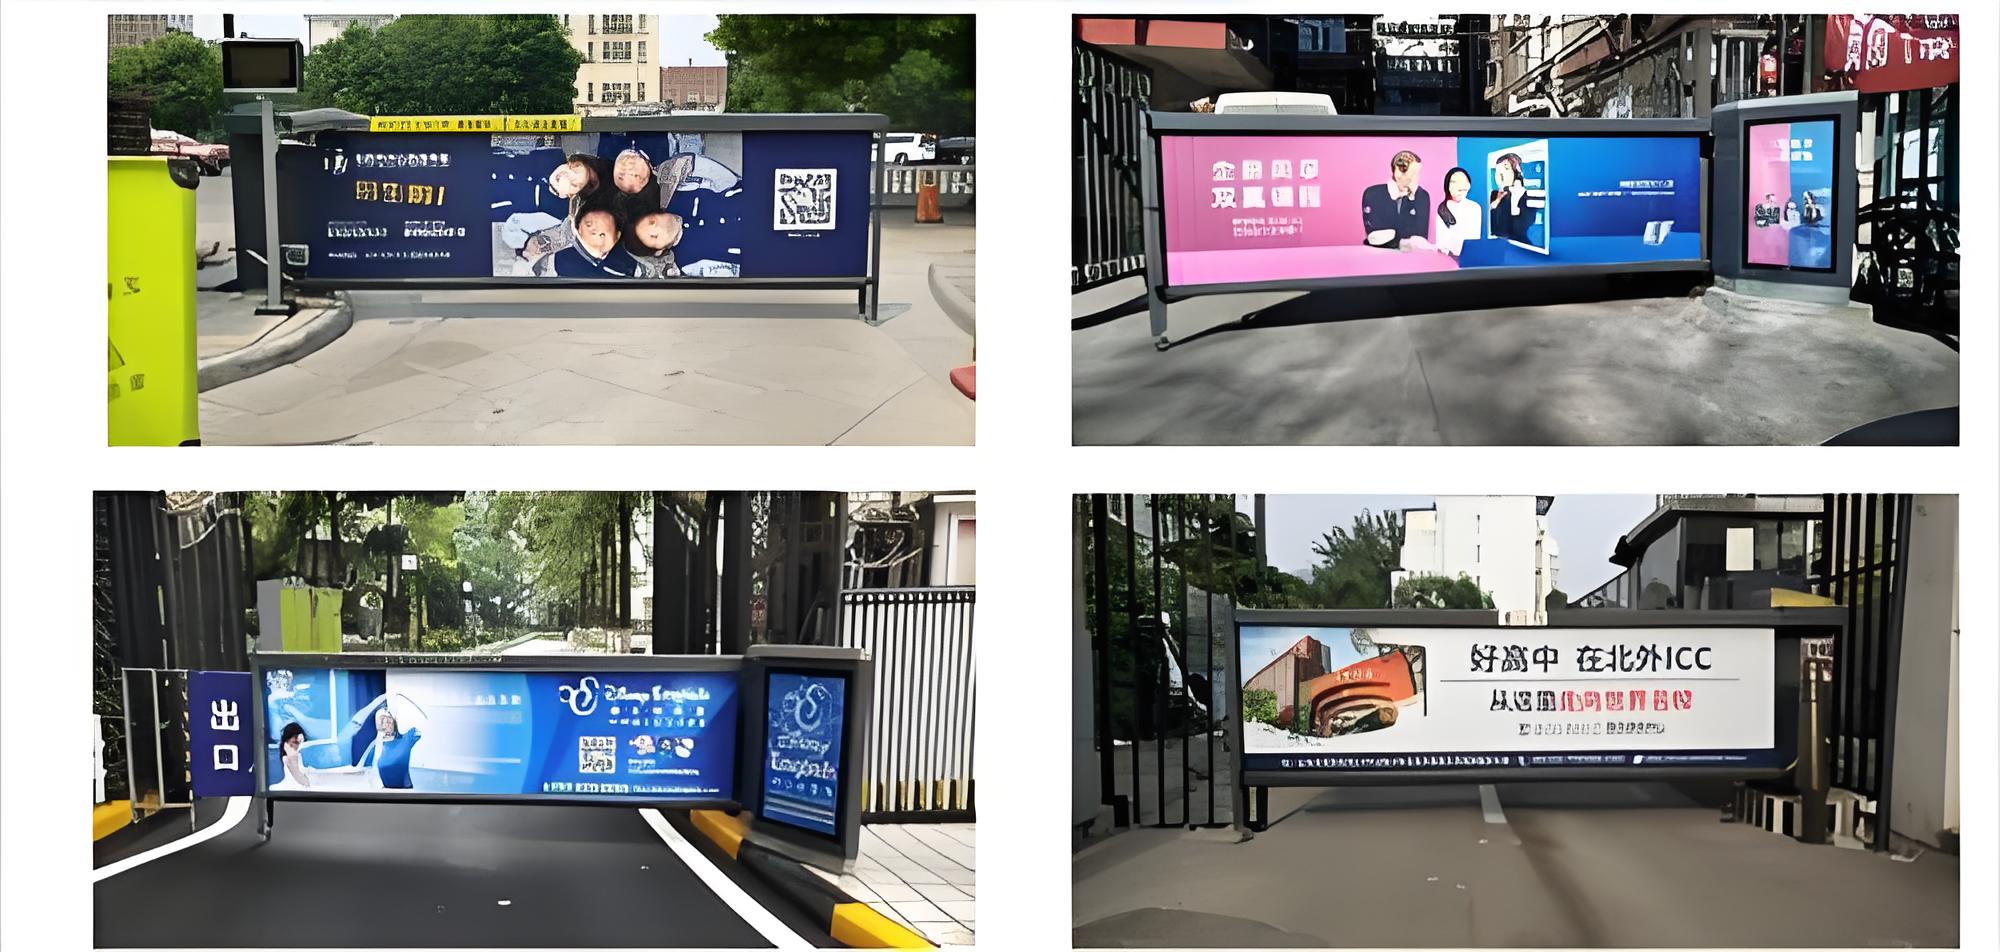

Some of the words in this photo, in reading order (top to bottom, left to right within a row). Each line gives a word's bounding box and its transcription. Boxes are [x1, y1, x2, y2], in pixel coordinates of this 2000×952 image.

[1576, 643, 1712, 673] 在北外ICC
[210, 699, 240, 771] 出口
